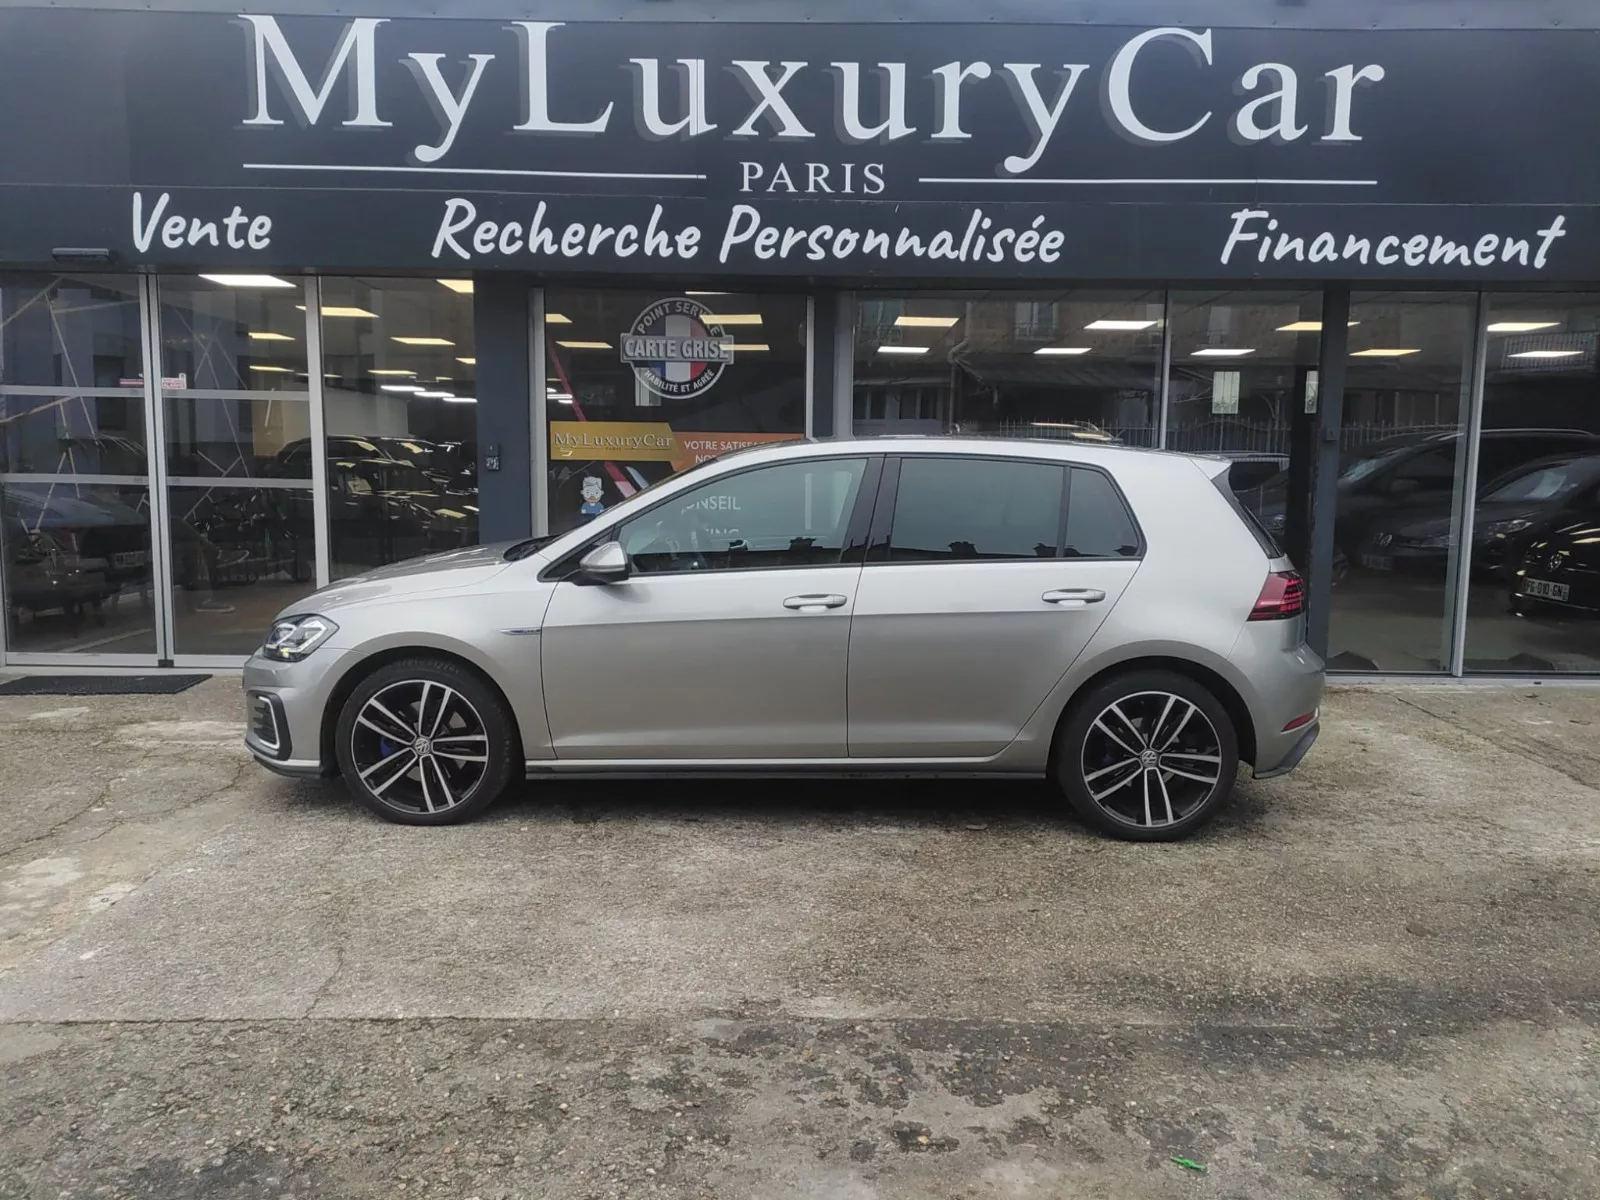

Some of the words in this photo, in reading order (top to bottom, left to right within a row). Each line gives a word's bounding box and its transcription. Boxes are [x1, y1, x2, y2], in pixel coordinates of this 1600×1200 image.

[238, 15, 1385, 172] MyLuxuryCar
[739, 162, 885, 194] PARIS
[133, 192, 272, 252] Vente
[432, 198, 701, 260] Recherche
[719, 205, 1065, 264] Personnalisée
[1221, 209, 1566, 269] Financement
[637, 303, 671, 334] POINT
[625, 340, 677, 358] CARTE
[682, 341, 729, 360] GRISE
[681, 384, 690, 393] ET
[554, 431, 673, 449] MyLuxuryCar
[684, 440, 717, 450] VOTRE
